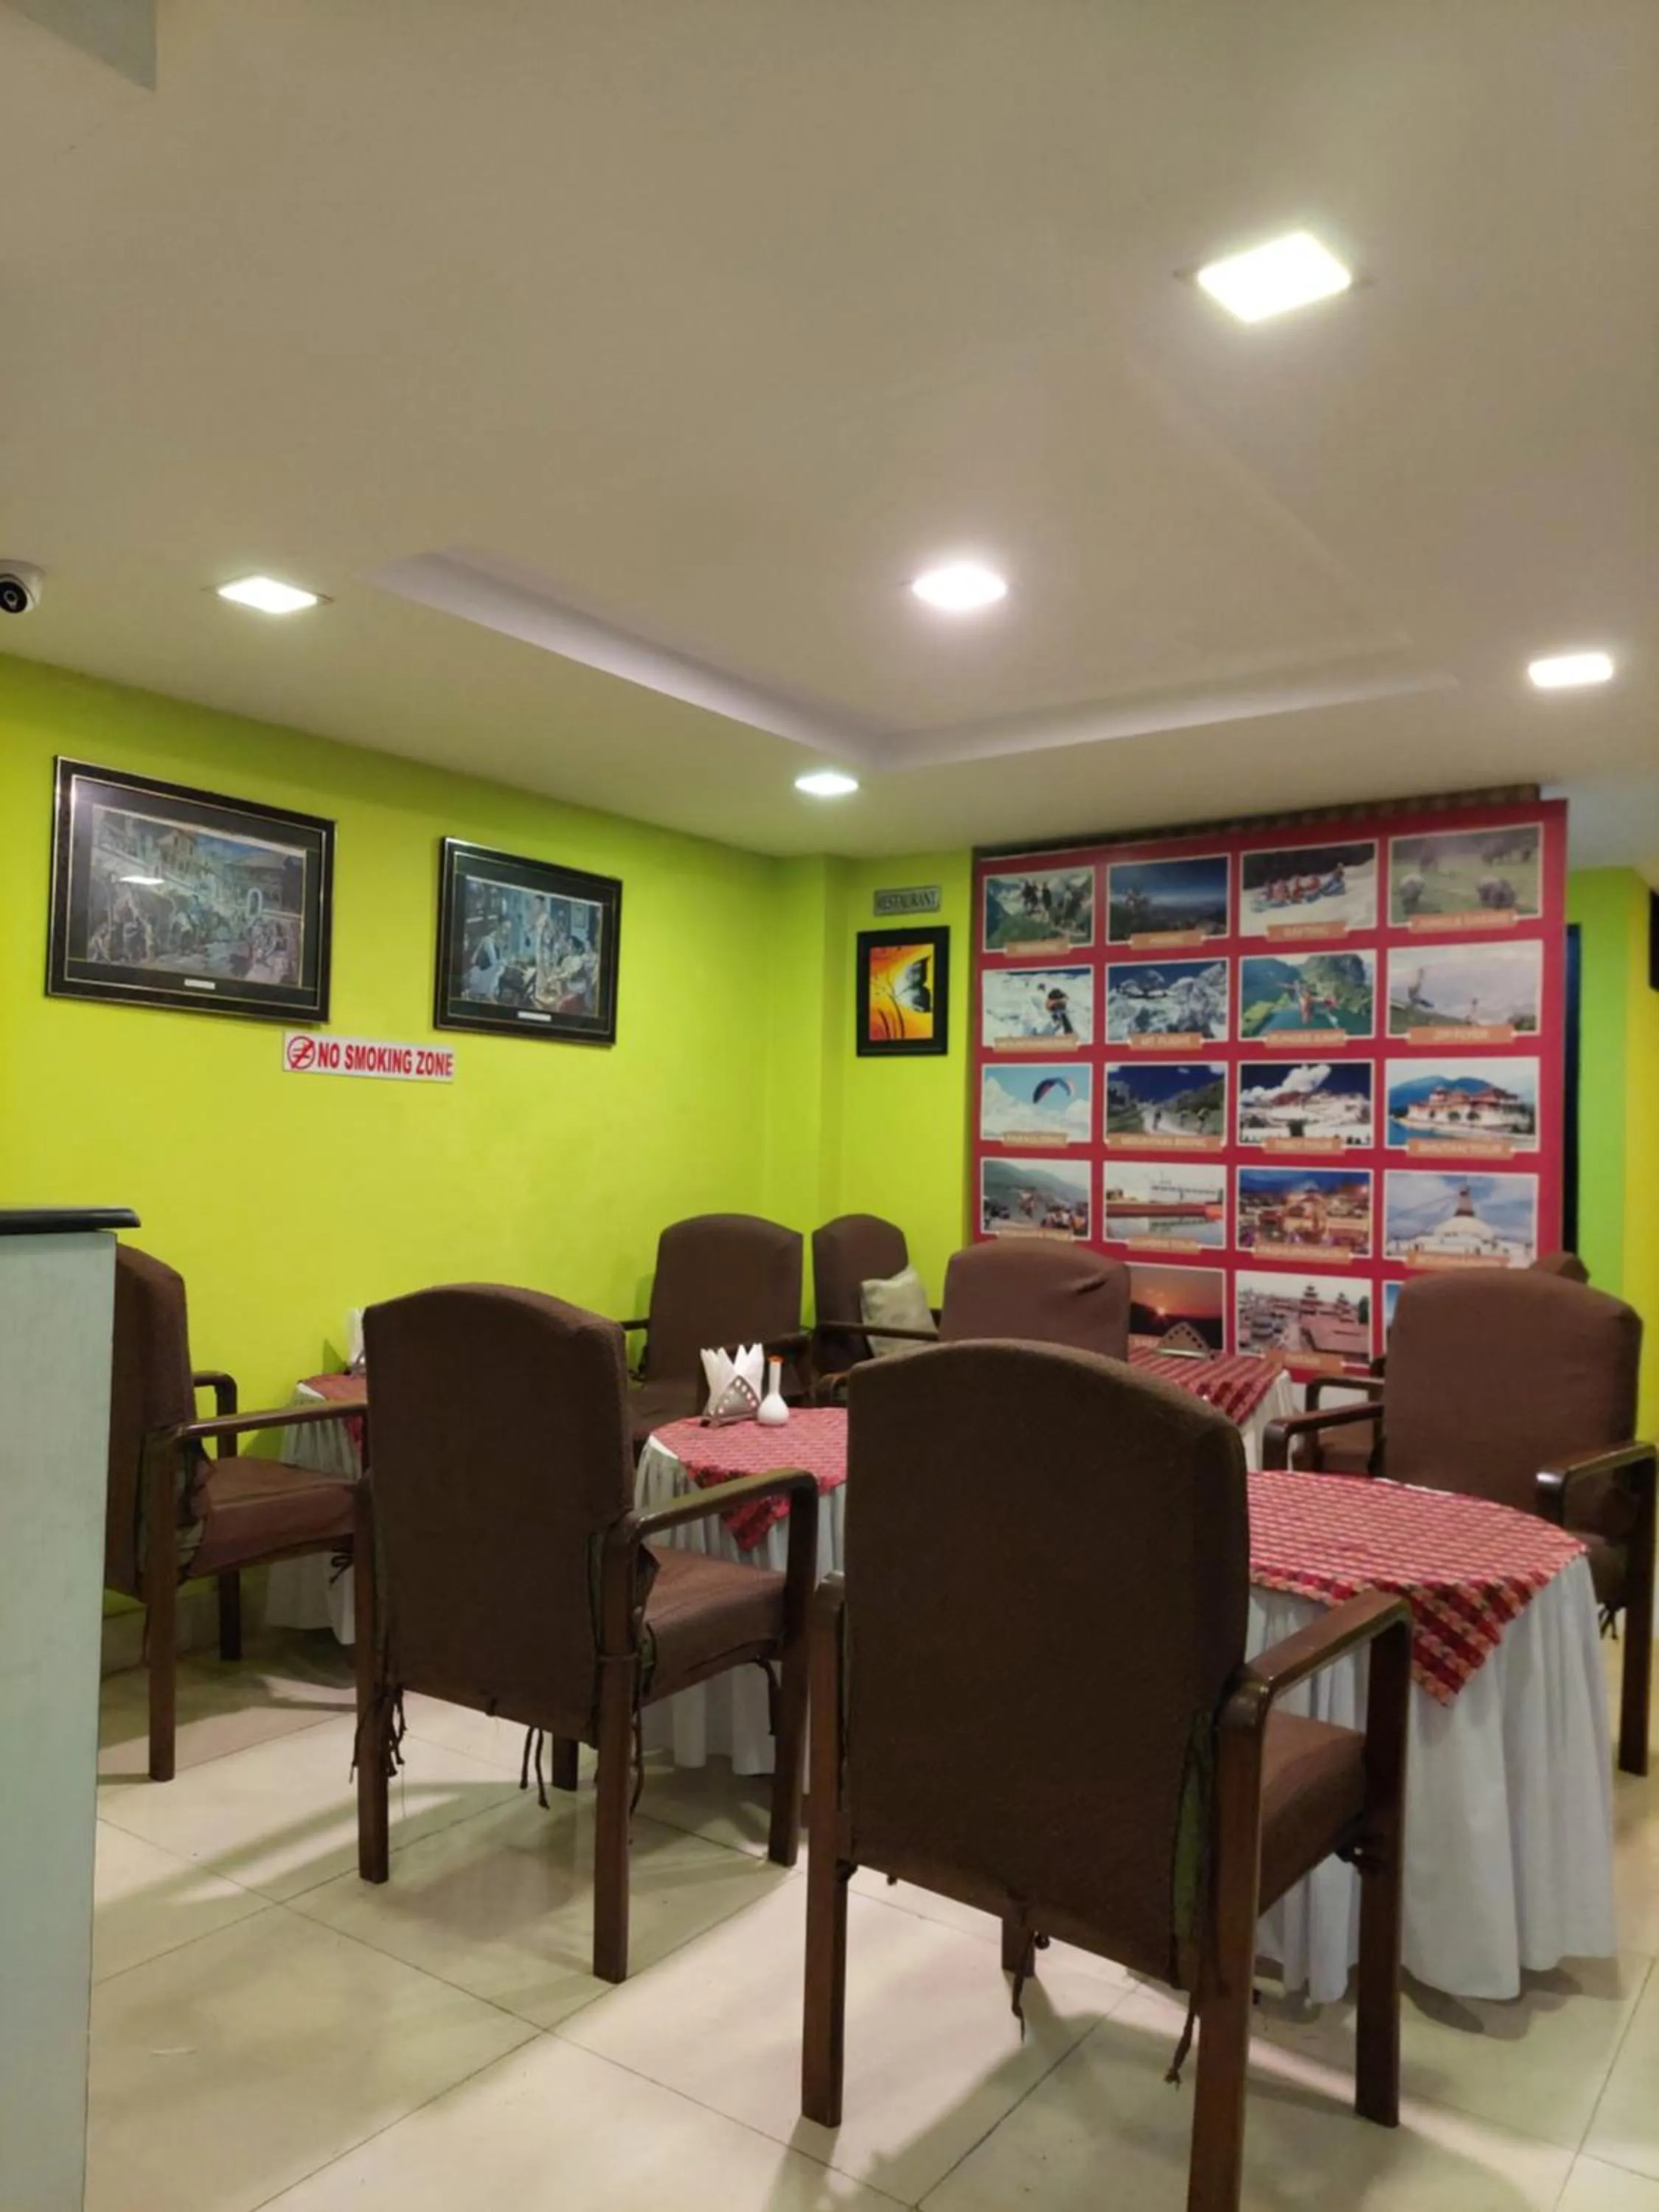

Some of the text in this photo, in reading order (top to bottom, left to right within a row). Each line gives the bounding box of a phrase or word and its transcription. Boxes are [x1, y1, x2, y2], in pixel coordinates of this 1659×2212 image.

[318, 1042, 453, 1076] NO SMOKING ZONE
